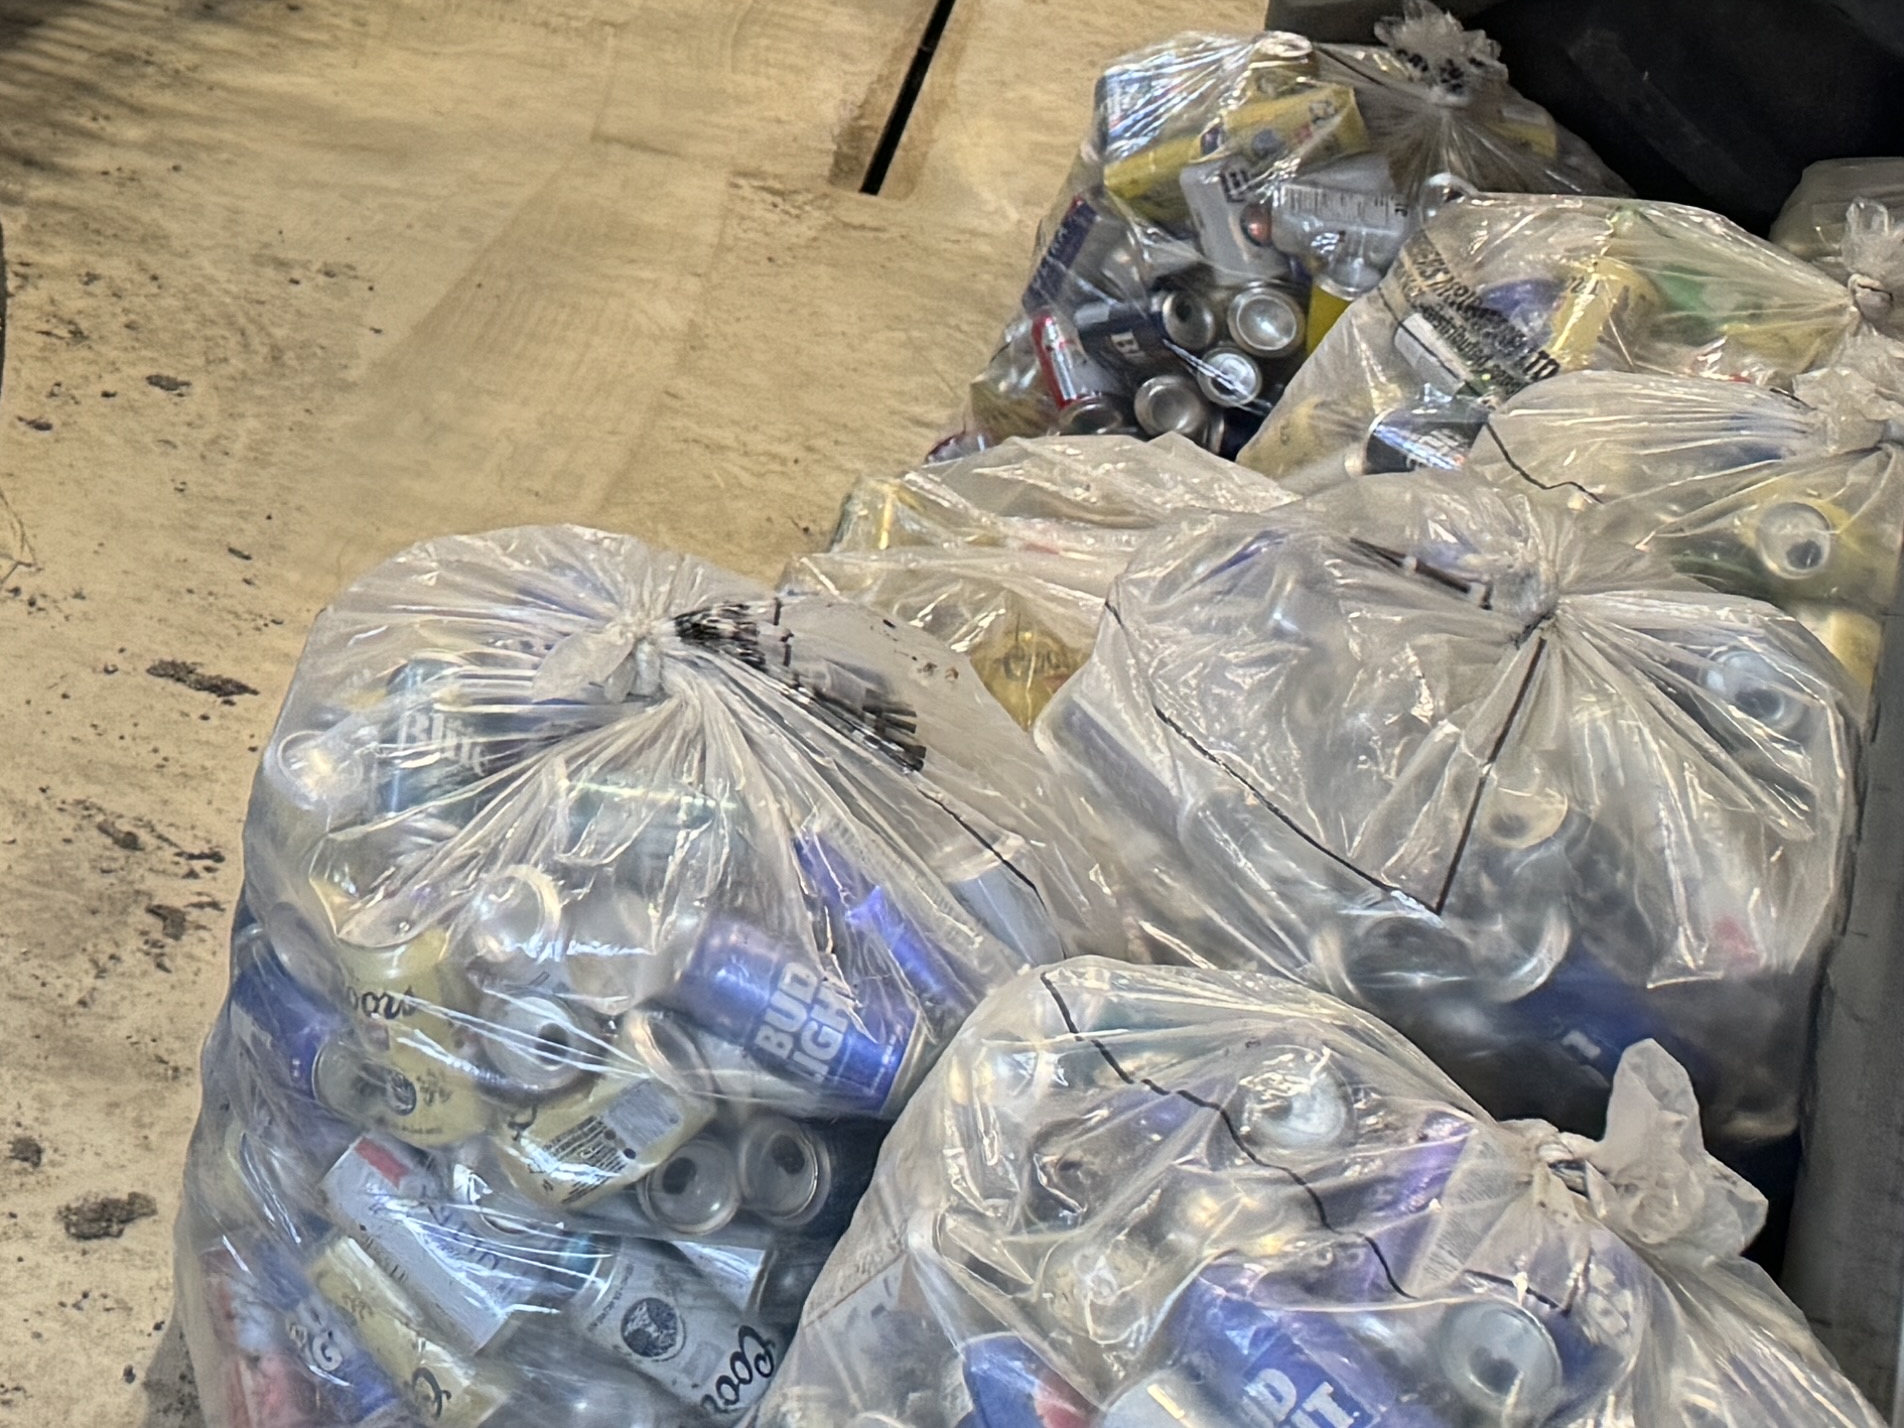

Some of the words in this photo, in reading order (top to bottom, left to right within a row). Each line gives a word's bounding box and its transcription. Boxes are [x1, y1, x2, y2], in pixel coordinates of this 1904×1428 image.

[347, 985, 418, 1020] oors
[753, 960, 819, 1061] BUD
[784, 982, 853, 1085] LIGH
